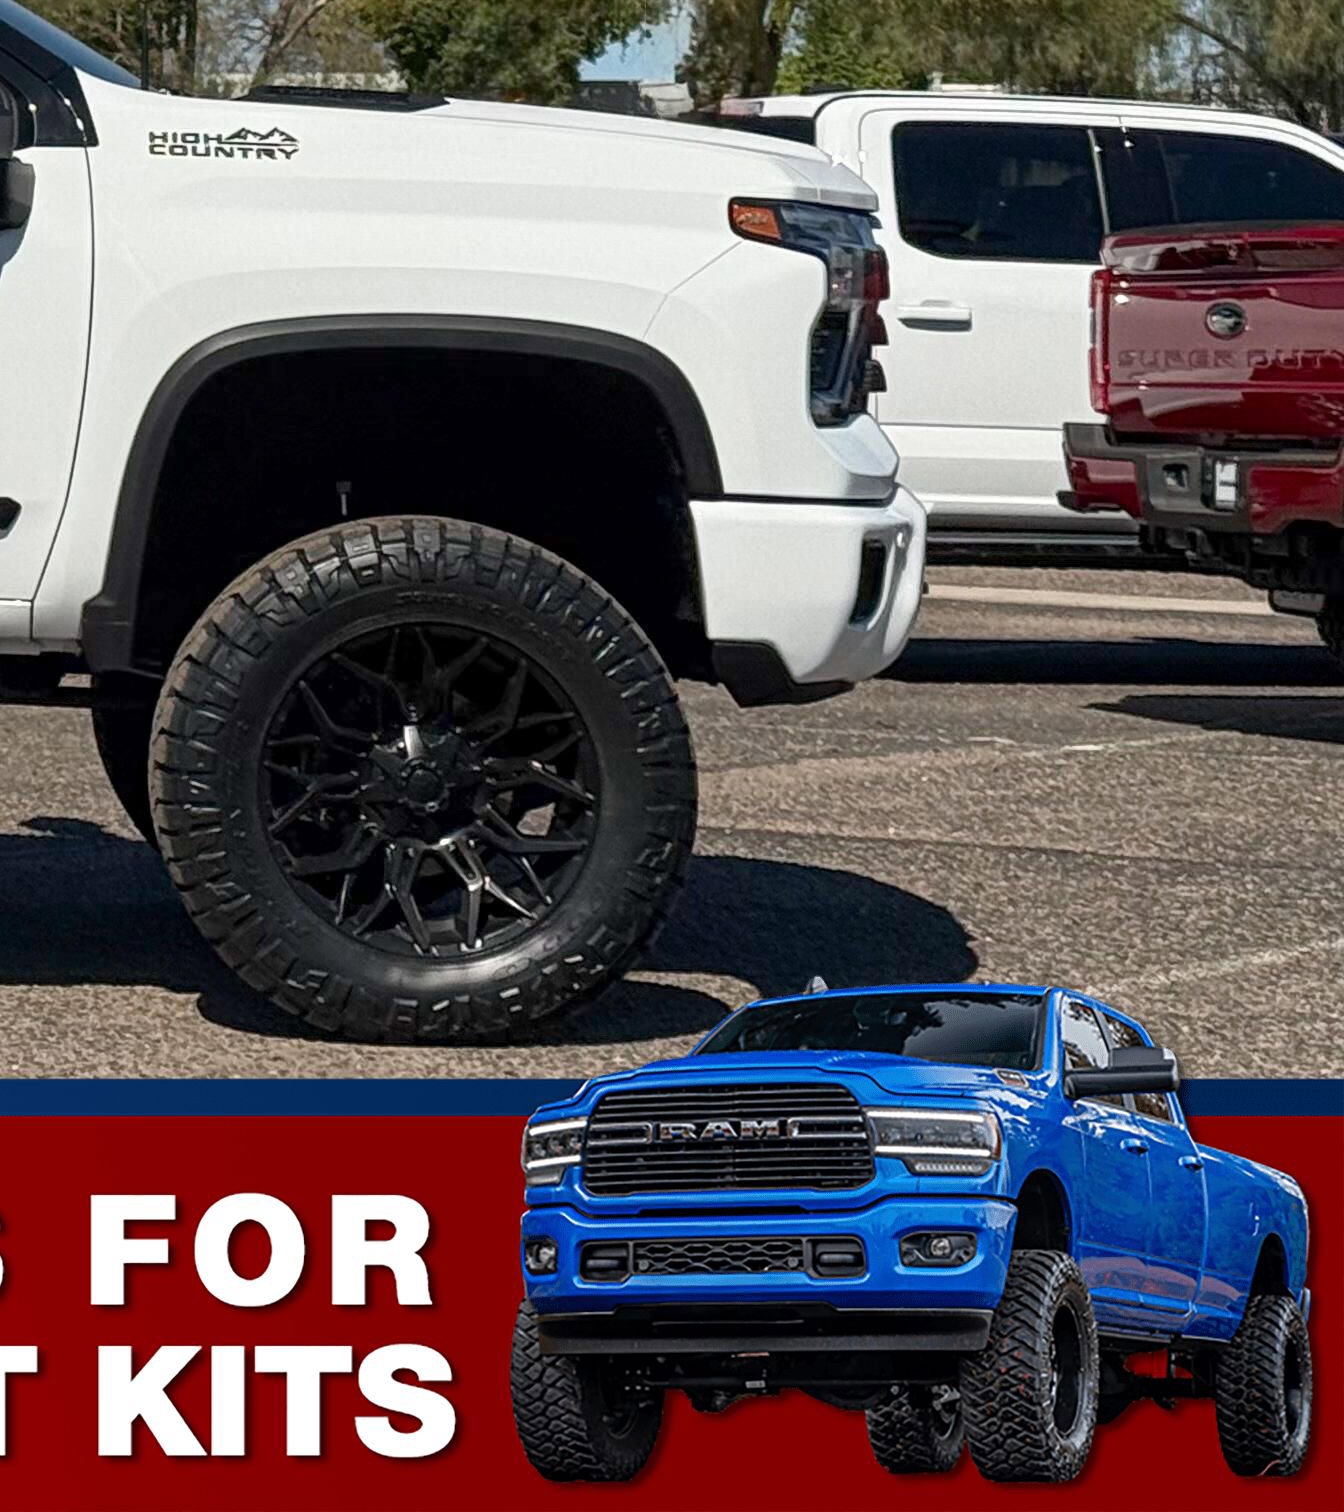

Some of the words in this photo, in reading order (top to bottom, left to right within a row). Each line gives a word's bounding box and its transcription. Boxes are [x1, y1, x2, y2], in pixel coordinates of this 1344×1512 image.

[148, 130, 223, 145] HIGH
[148, 144, 300, 160] COUNTRY
[1117, 348, 1234, 370] SUPER
